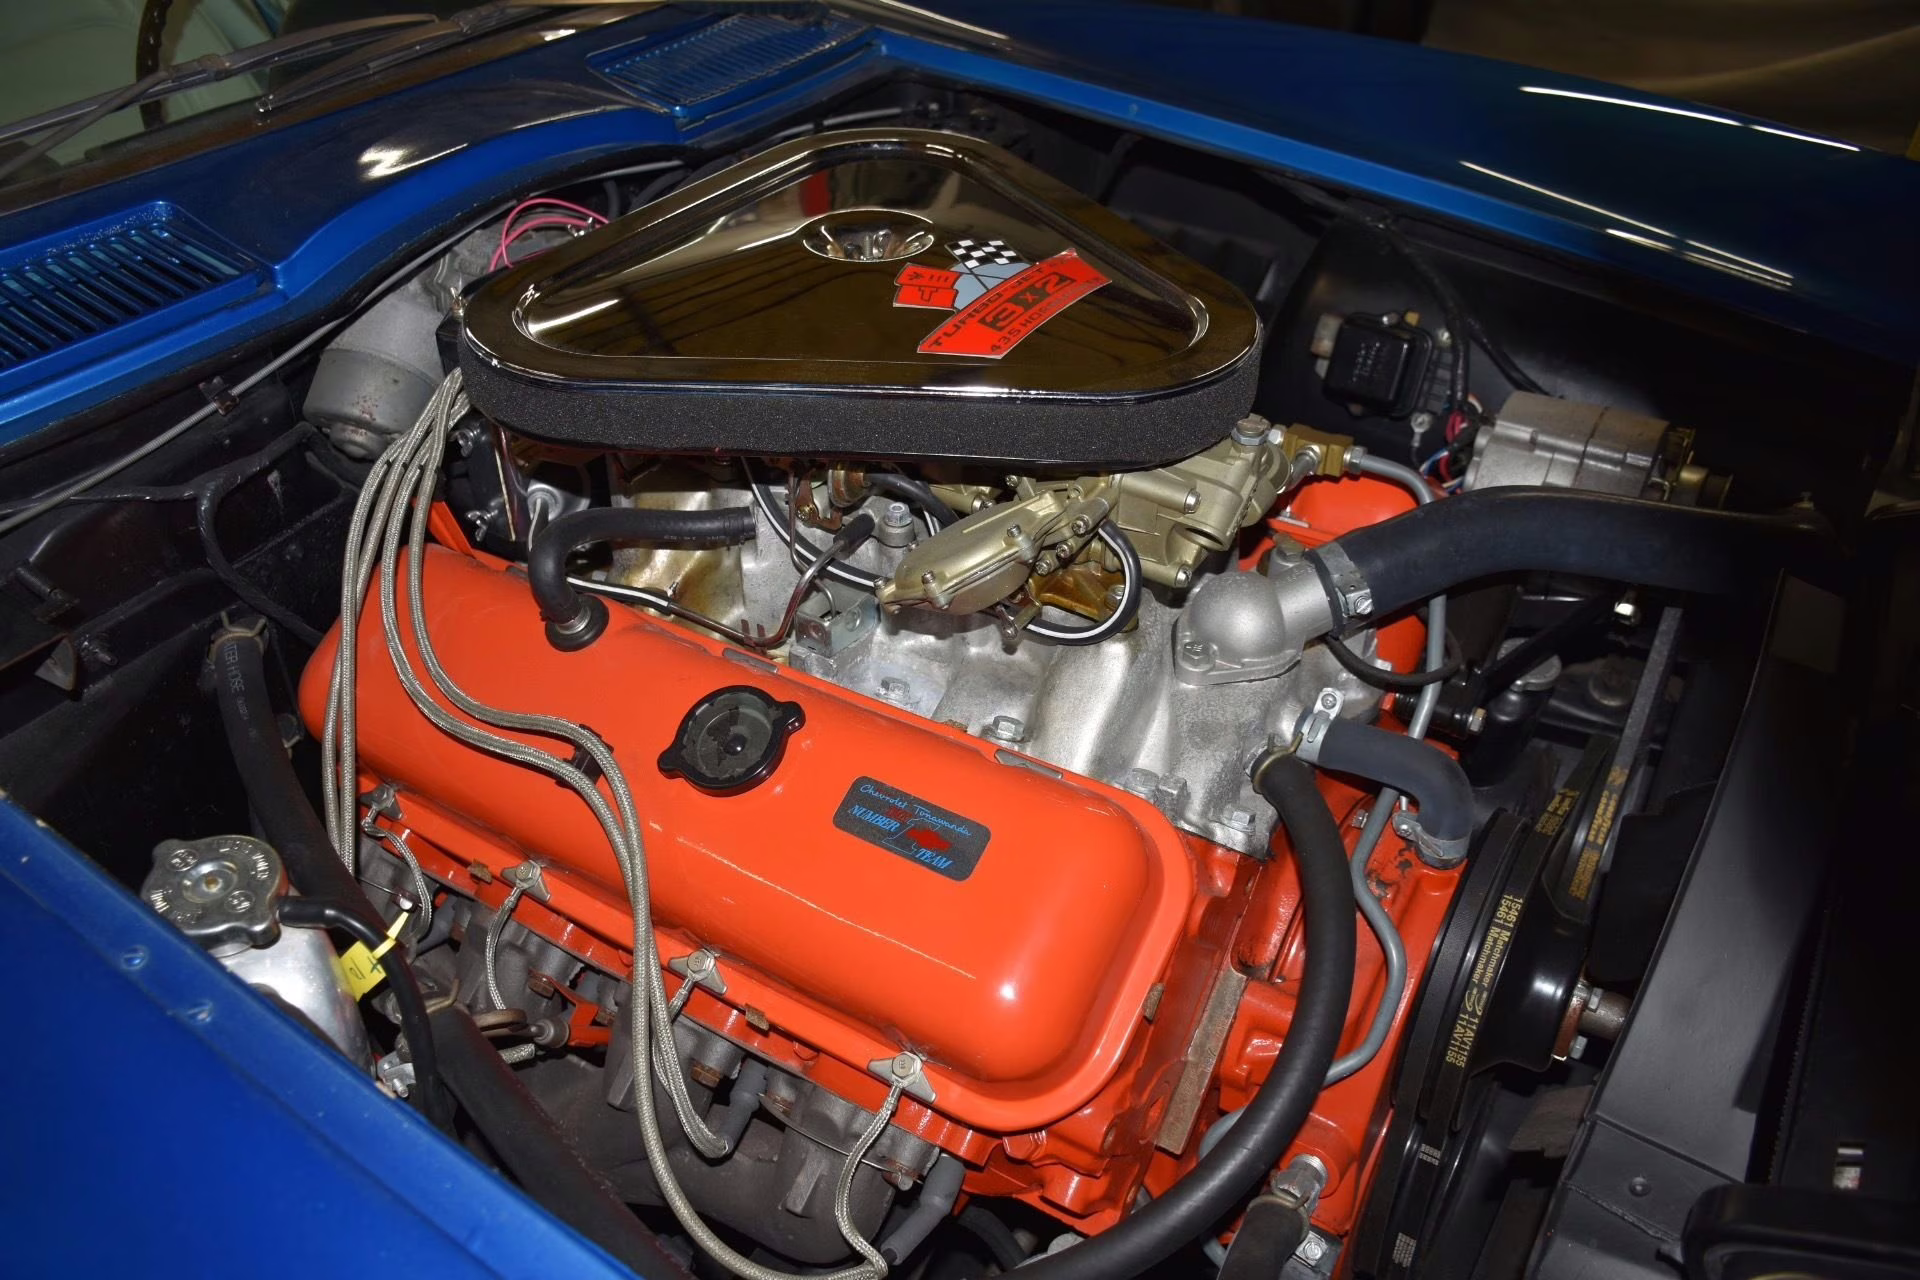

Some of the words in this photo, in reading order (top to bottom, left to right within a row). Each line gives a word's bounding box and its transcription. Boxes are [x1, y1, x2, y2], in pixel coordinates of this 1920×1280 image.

[989, 327, 1022, 353] 435
[859, 784, 909, 809] Chevrolet
[913, 803, 972, 836] Tonawanda
[849, 803, 901, 833] NUMBER
[914, 847, 954, 870] TEAM
[1493, 893, 1513, 925] 15461
[1506, 897, 1523, 928] 15461
[1471, 925, 1502, 984] Matchmaker
[1482, 929, 1512, 988] Matchmaker
[1444, 1012, 1469, 1064] 11AV1155
[1454, 1017, 1480, 1068] 11AV1155
